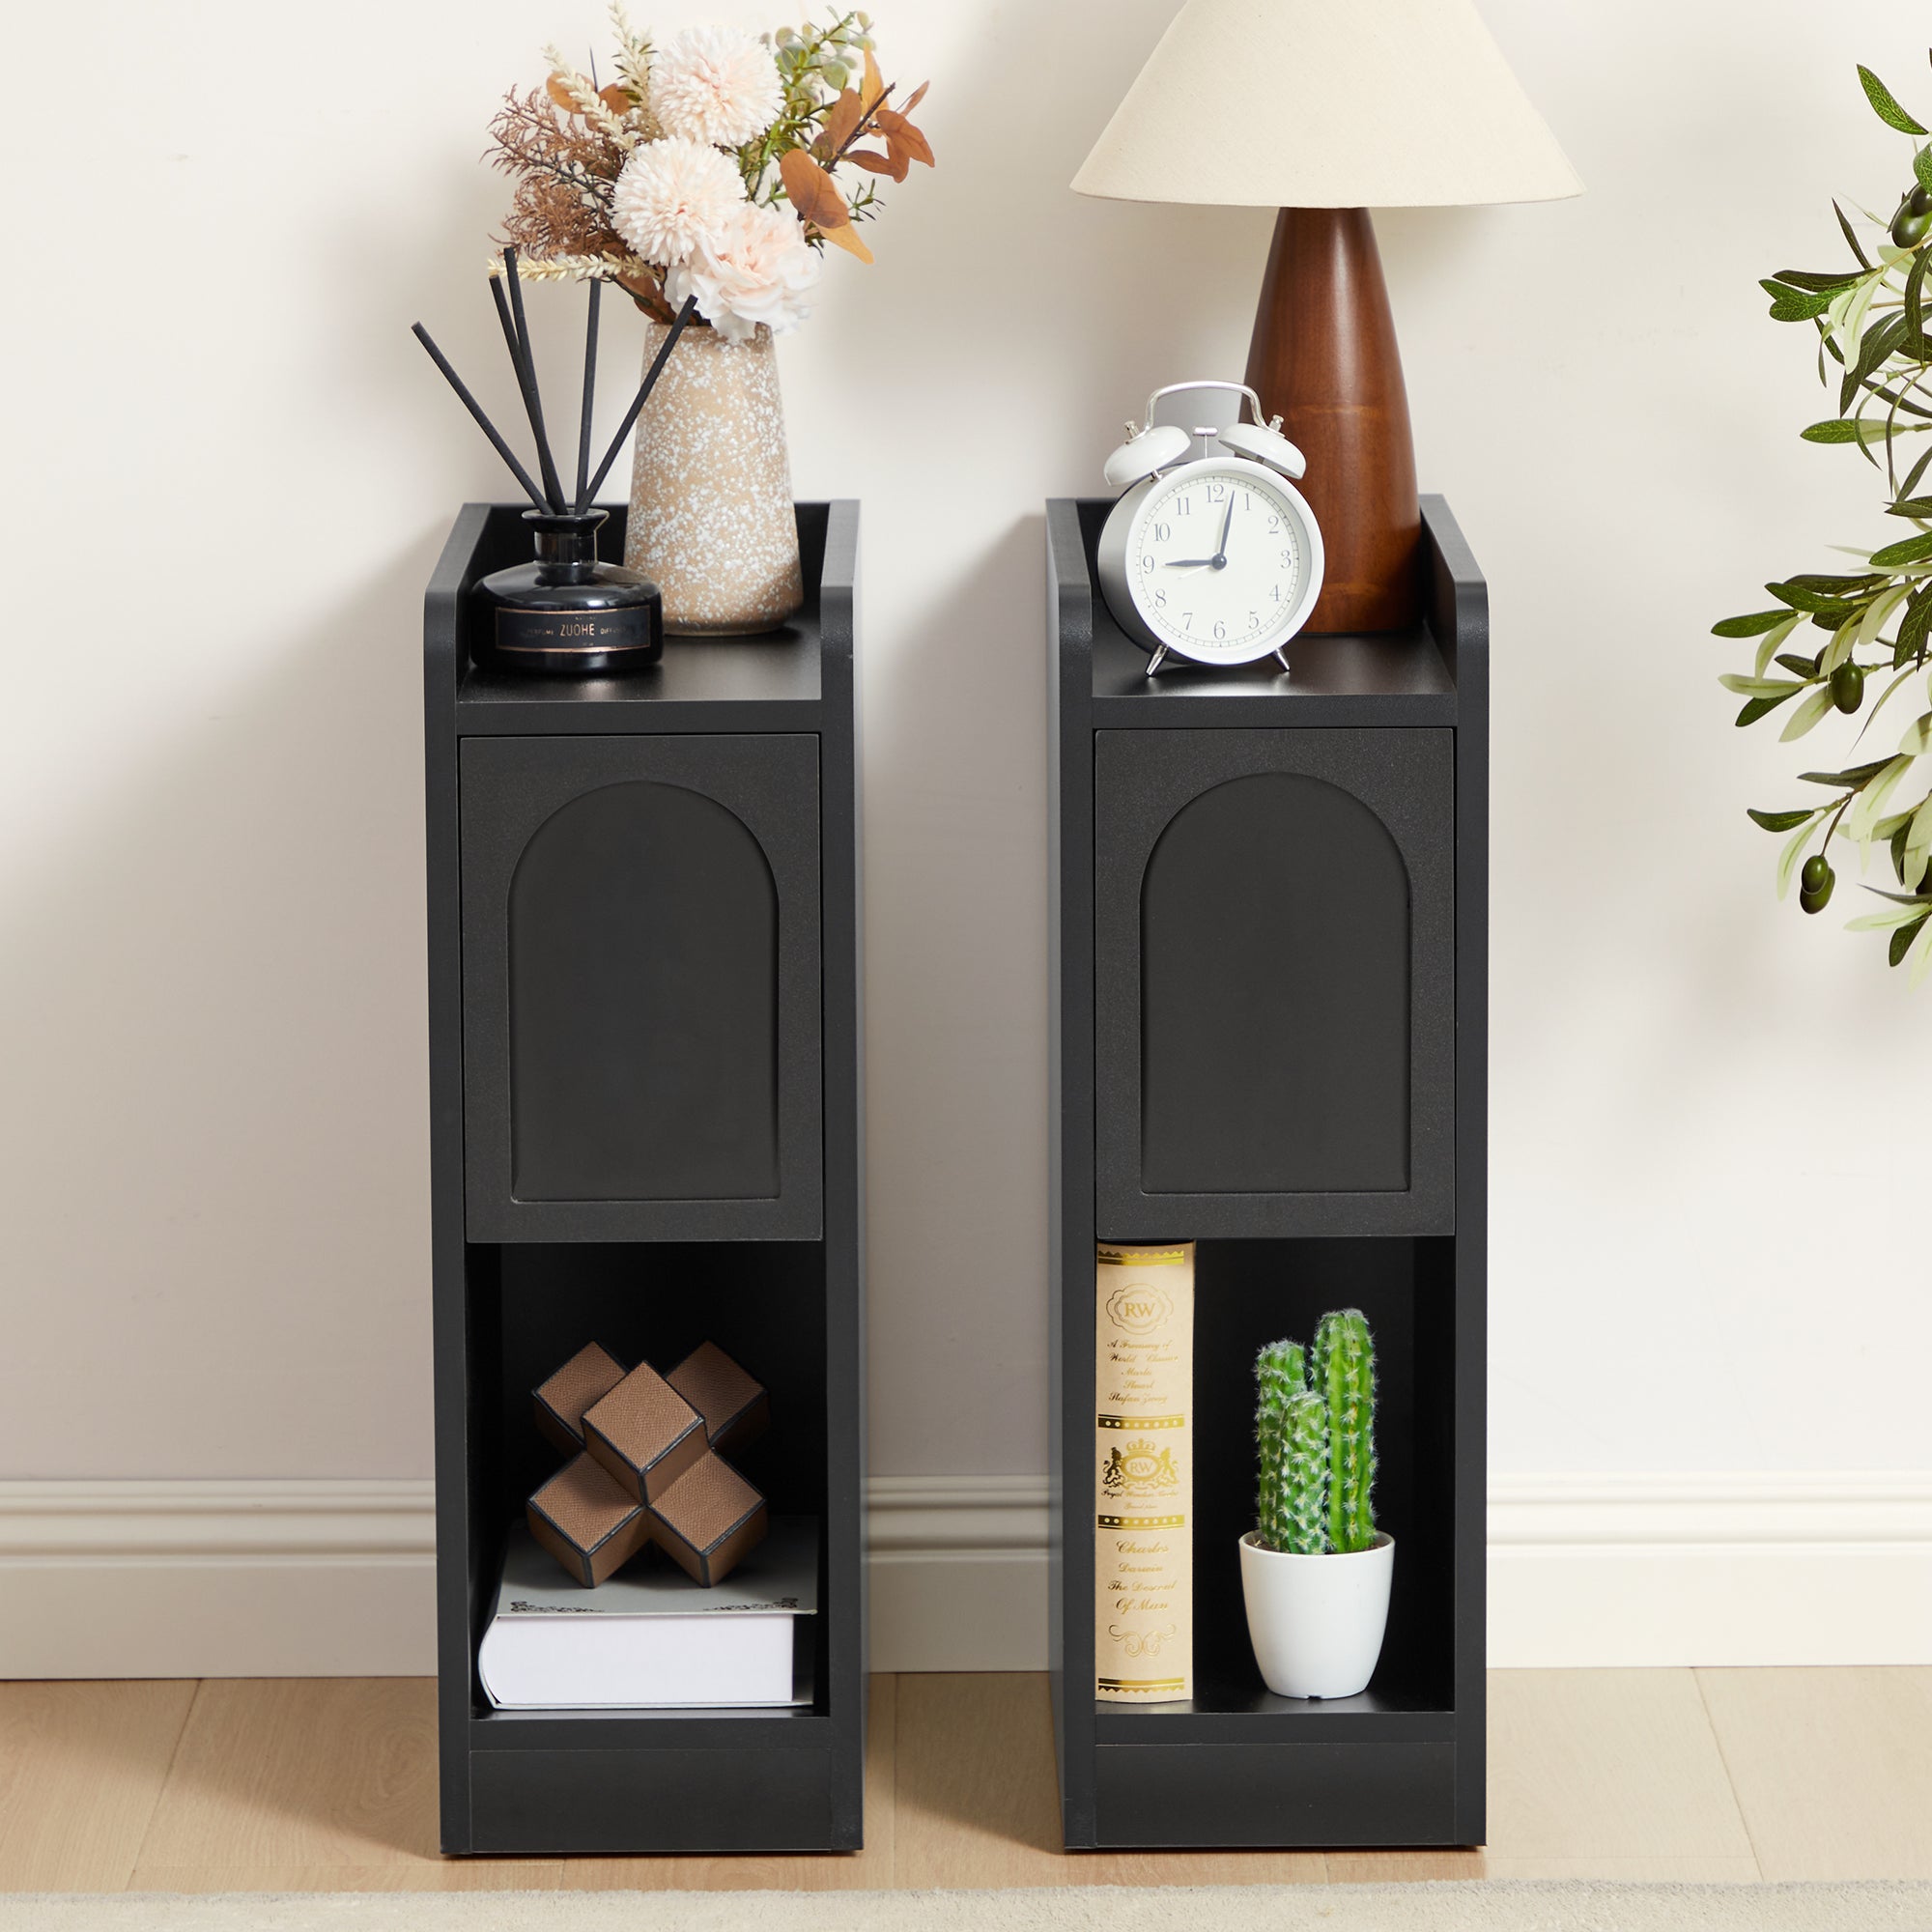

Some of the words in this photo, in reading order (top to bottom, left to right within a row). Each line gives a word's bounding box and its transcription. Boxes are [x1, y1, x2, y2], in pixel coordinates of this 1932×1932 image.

[1207, 483, 1224, 503] 12
[1244, 493, 1251, 511] 1
[1177, 497, 1191, 516] 11
[1153, 523, 1171, 542] 10
[1267, 516, 1279, 534] 2
[1143, 555, 1154, 575] 9
[1280, 550, 1292, 569] 3
[1154, 588, 1167, 609] 8
[1268, 584, 1282, 602] 4
[1181, 611, 1193, 631] 7
[1213, 620, 1226, 639] 6
[1248, 611, 1260, 630] 5
[559, 623, 595, 637] ZUOHE
[1123, 1301, 1156, 1318] RW
[1129, 1461, 1153, 1473] RW
[1116, 1540, 1170, 1554] Charles
[1118, 1561, 1163, 1573] Darwin
[1107, 1579, 1129, 1591] The
[1115, 1597, 1135, 1615] Of
[1135, 1598, 1169, 1611] Man
